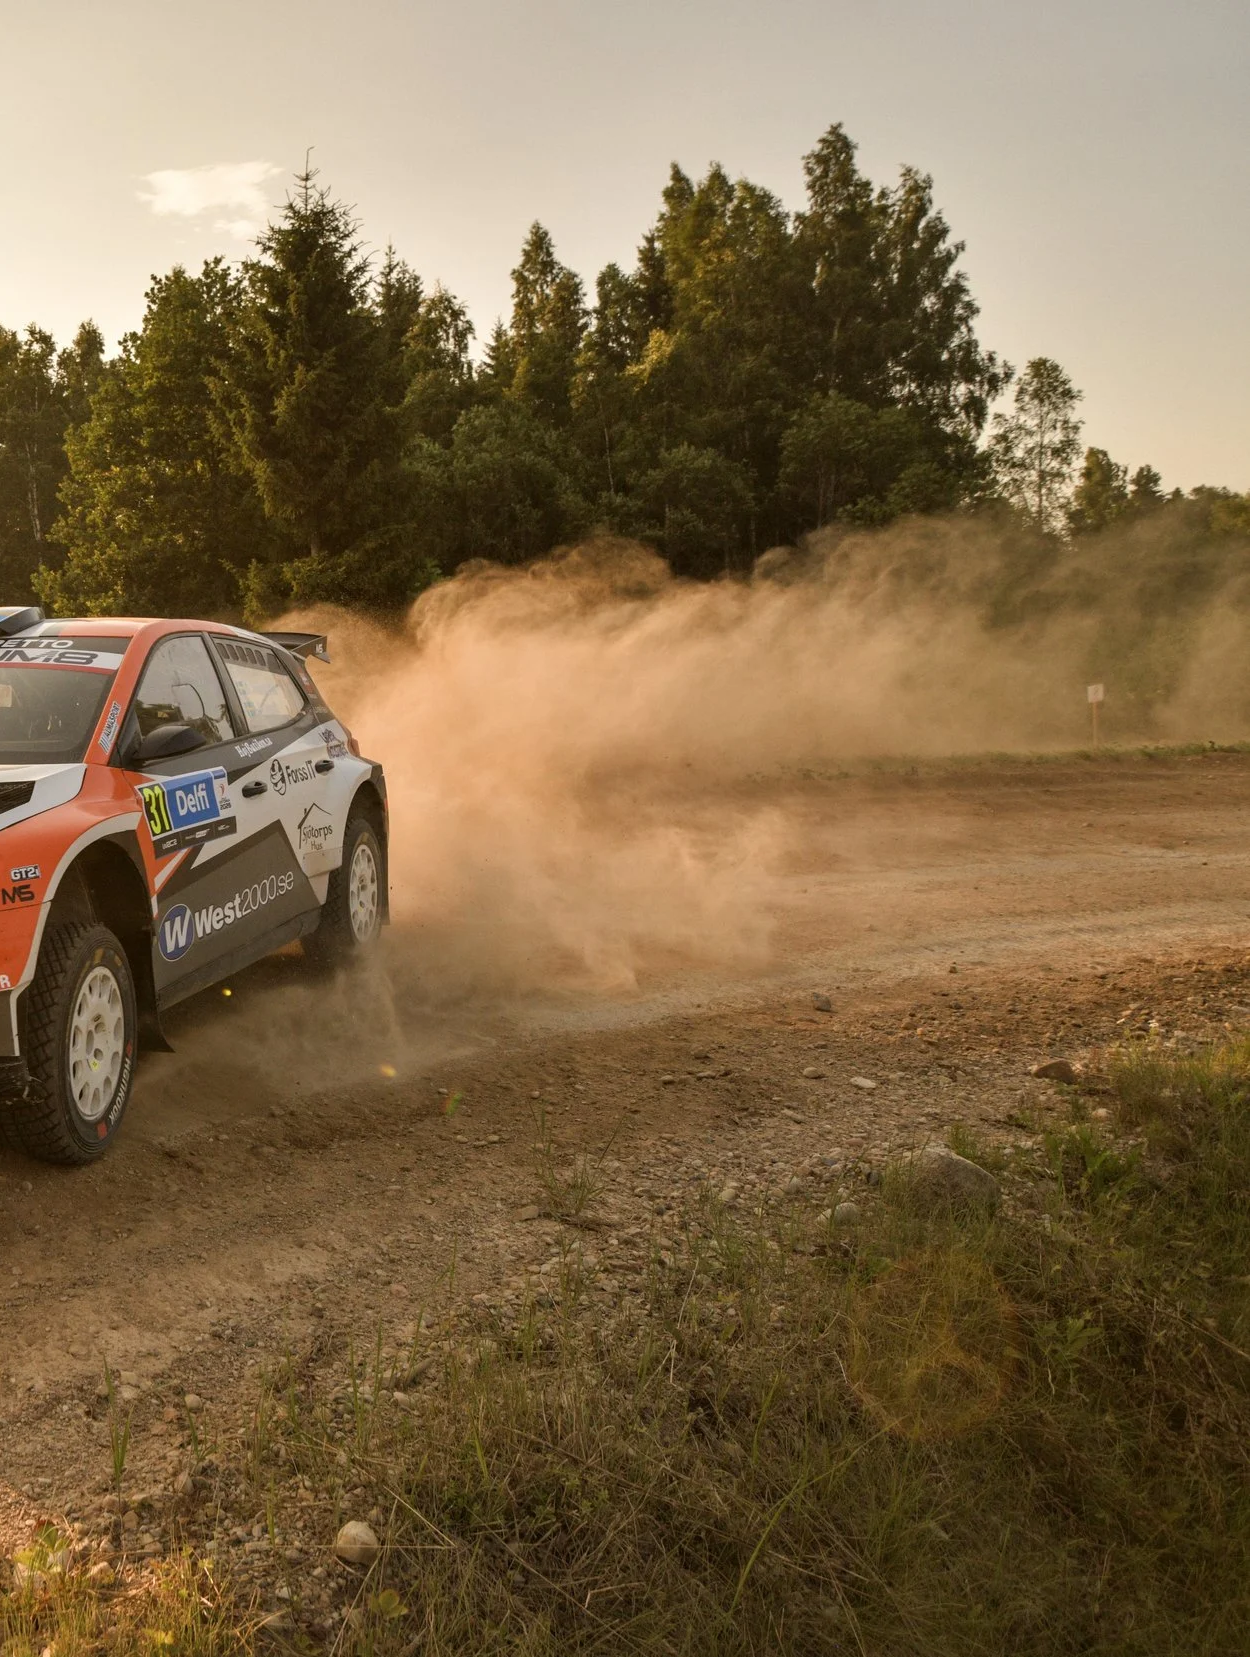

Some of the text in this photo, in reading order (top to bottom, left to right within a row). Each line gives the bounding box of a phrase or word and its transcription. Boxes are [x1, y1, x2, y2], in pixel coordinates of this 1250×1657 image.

[143, 785, 170, 834] 31
[175, 783, 210, 816] Delfi
[11, 864, 40, 880] GT2i
[1, 884, 35, 905] MS
[194, 871, 294, 938] West2000.se
